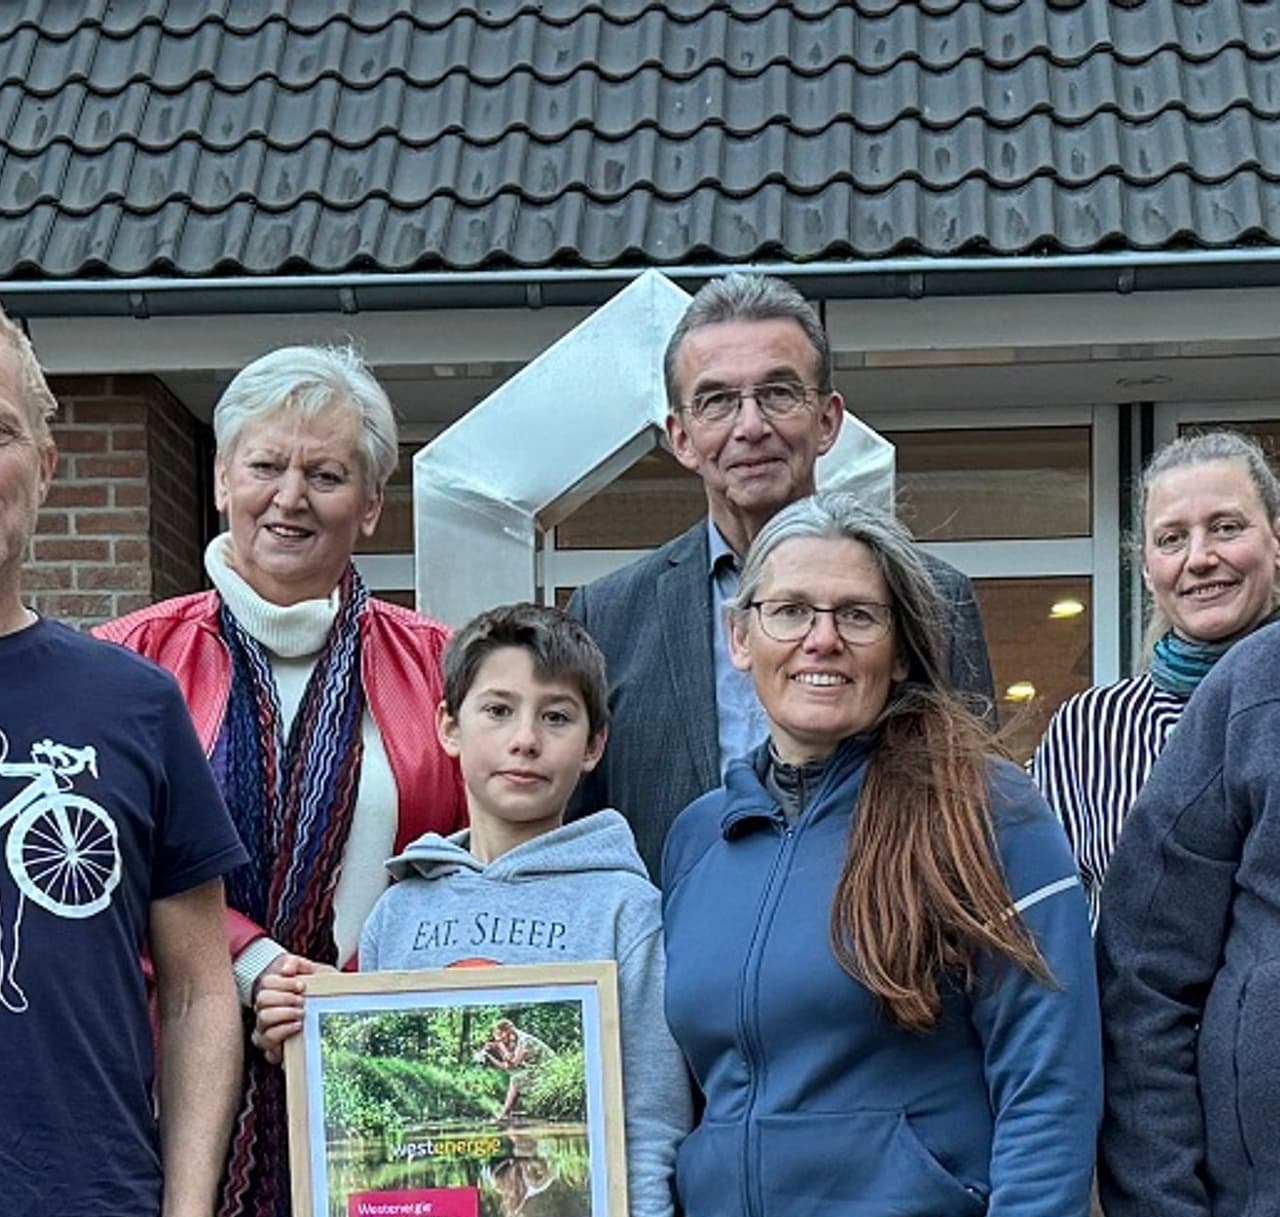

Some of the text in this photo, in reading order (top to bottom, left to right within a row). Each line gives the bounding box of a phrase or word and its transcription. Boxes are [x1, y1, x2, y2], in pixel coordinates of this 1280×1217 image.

[412, 911, 567, 951] EAT. SLEEP.
[392, 1137, 501, 1159] westenergie
[357, 1202, 433, 1215] Westenergie
